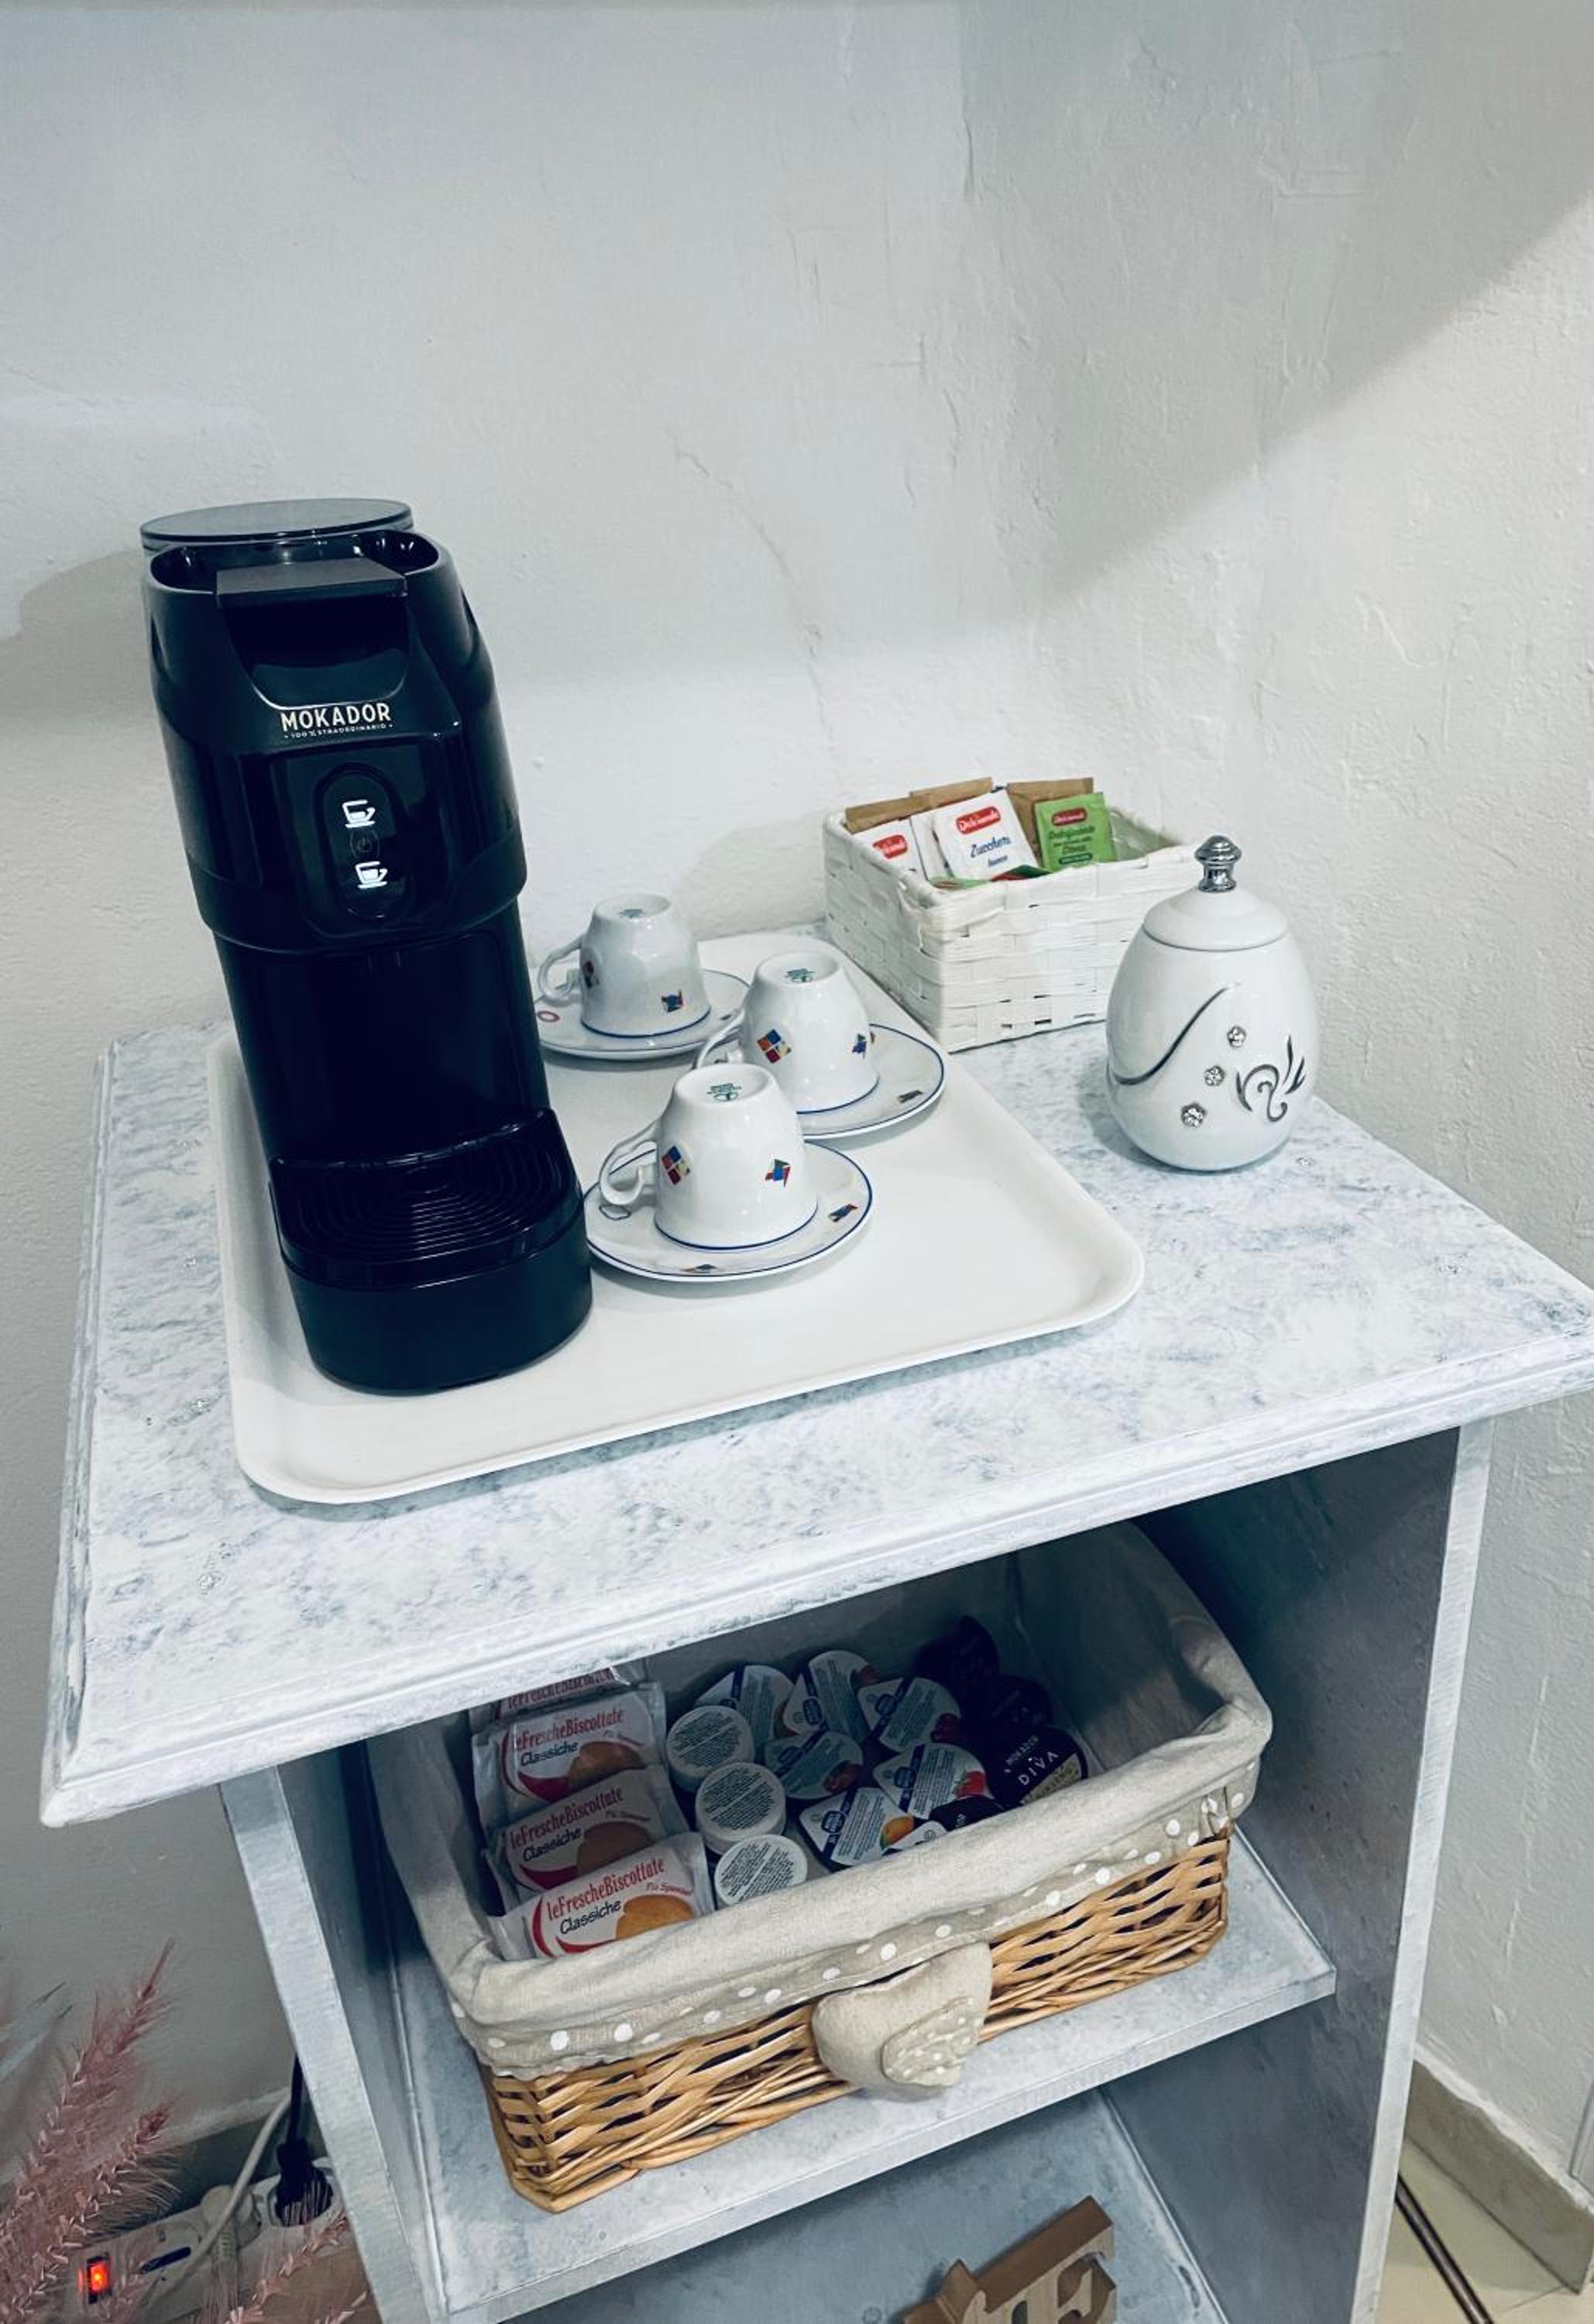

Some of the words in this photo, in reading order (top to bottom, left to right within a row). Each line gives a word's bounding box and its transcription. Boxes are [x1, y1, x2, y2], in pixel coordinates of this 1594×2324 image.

[280, 703, 391, 732] MOKADOR
[514, 1707, 623, 1750] eFrescheBiscottate
[520, 1741, 579, 1766] Classiche
[1018, 1752, 1059, 1786] DIVA
[523, 1827, 581, 1862] Classiche
[546, 1858, 665, 1921] leFrescheBiscottate
[559, 1899, 621, 1934] Classiche
